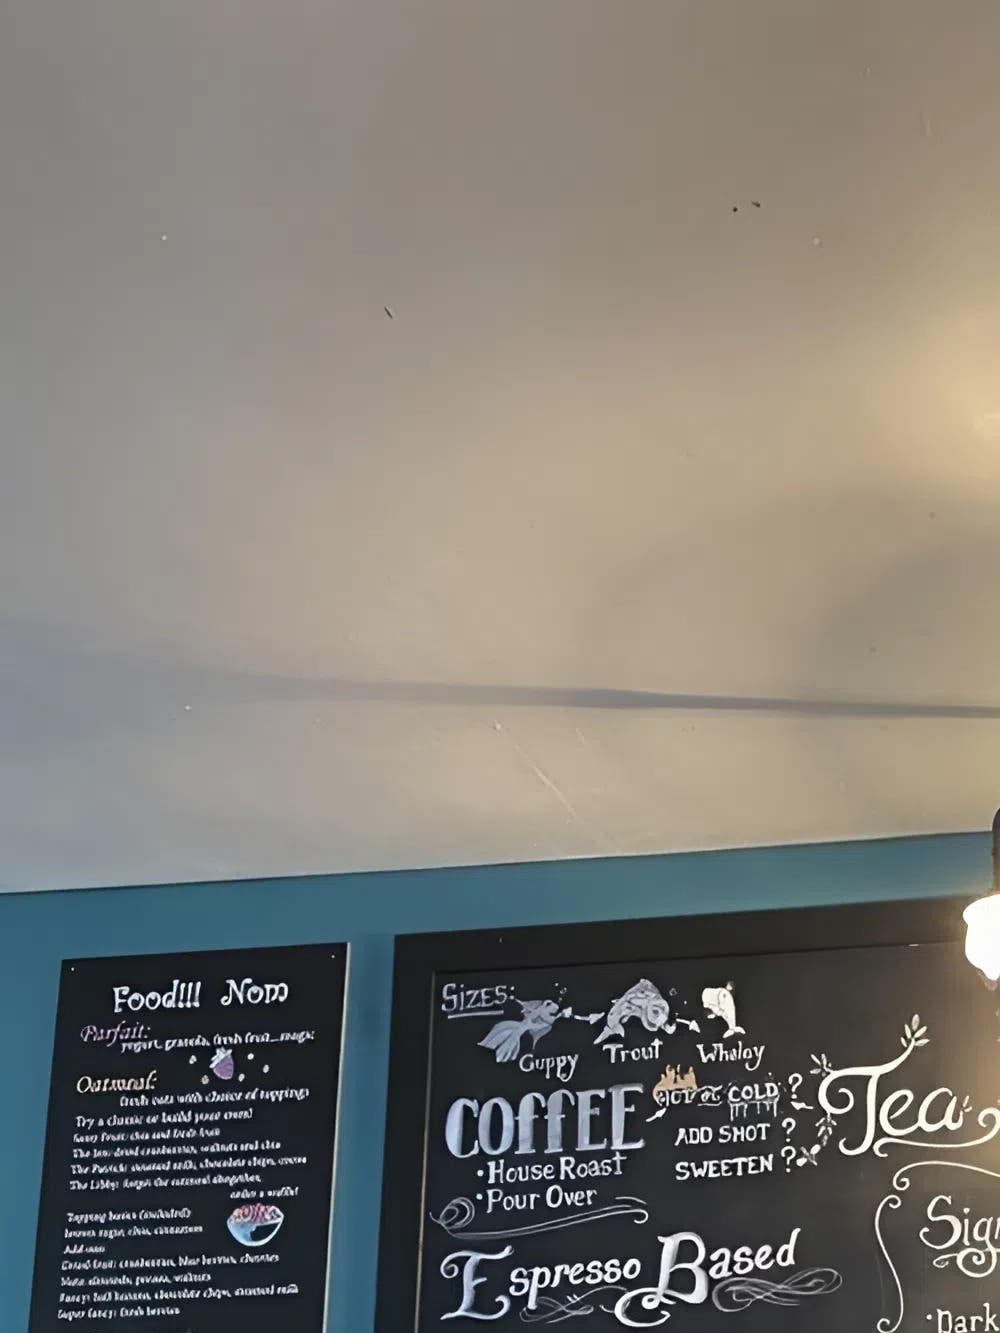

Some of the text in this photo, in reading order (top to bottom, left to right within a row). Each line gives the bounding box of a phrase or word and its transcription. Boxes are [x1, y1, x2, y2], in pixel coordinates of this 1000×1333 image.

[113, 978, 289, 1013] Food!!! Nom
[519, 1053, 579, 1082] Guppy
[603, 1038, 663, 1063] Trout
[728, 1082, 779, 1103] COLD
[818, 1036, 964, 1157] Tea
[674, 1117, 796, 1146] ADD SHOT ?
[487, 1151, 627, 1184] House Roast
[674, 1146, 796, 1181] SWEETEN ?
[486, 1185, 598, 1214] Pour Over
[440, 1227, 802, 1327] Espresso Based
[936, 1302, 1000, 1333] Dark
